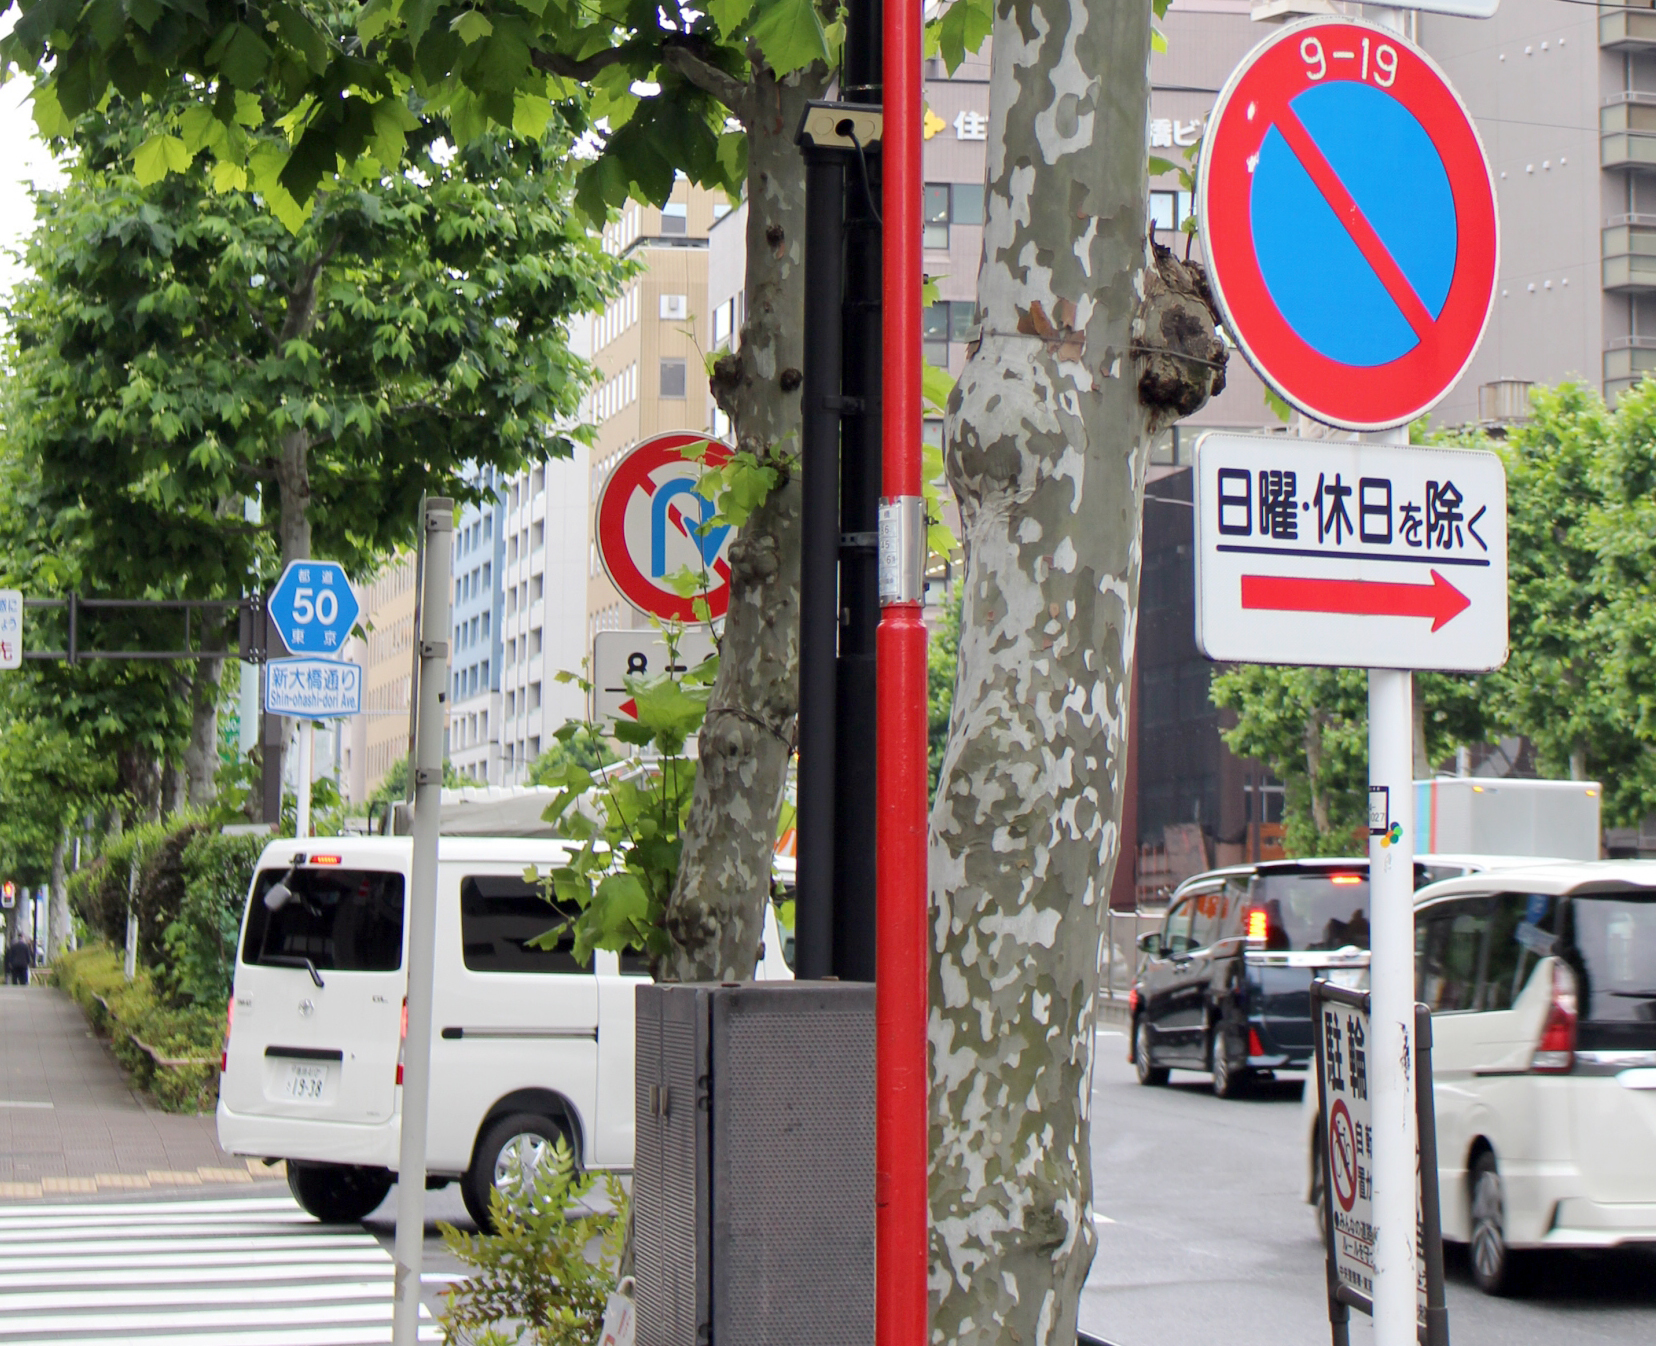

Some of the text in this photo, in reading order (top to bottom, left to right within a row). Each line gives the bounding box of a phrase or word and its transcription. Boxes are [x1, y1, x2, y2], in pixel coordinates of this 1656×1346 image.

[1300, 36, 1399, 87] 9-19
[1217, 466, 1488, 552] 日曜・休日を除く
[298, 569, 333, 585] 都道
[292, 587, 339, 626] 50
[292, 628, 337, 646] 東京
[272, 666, 355, 691] 新大橋通り
